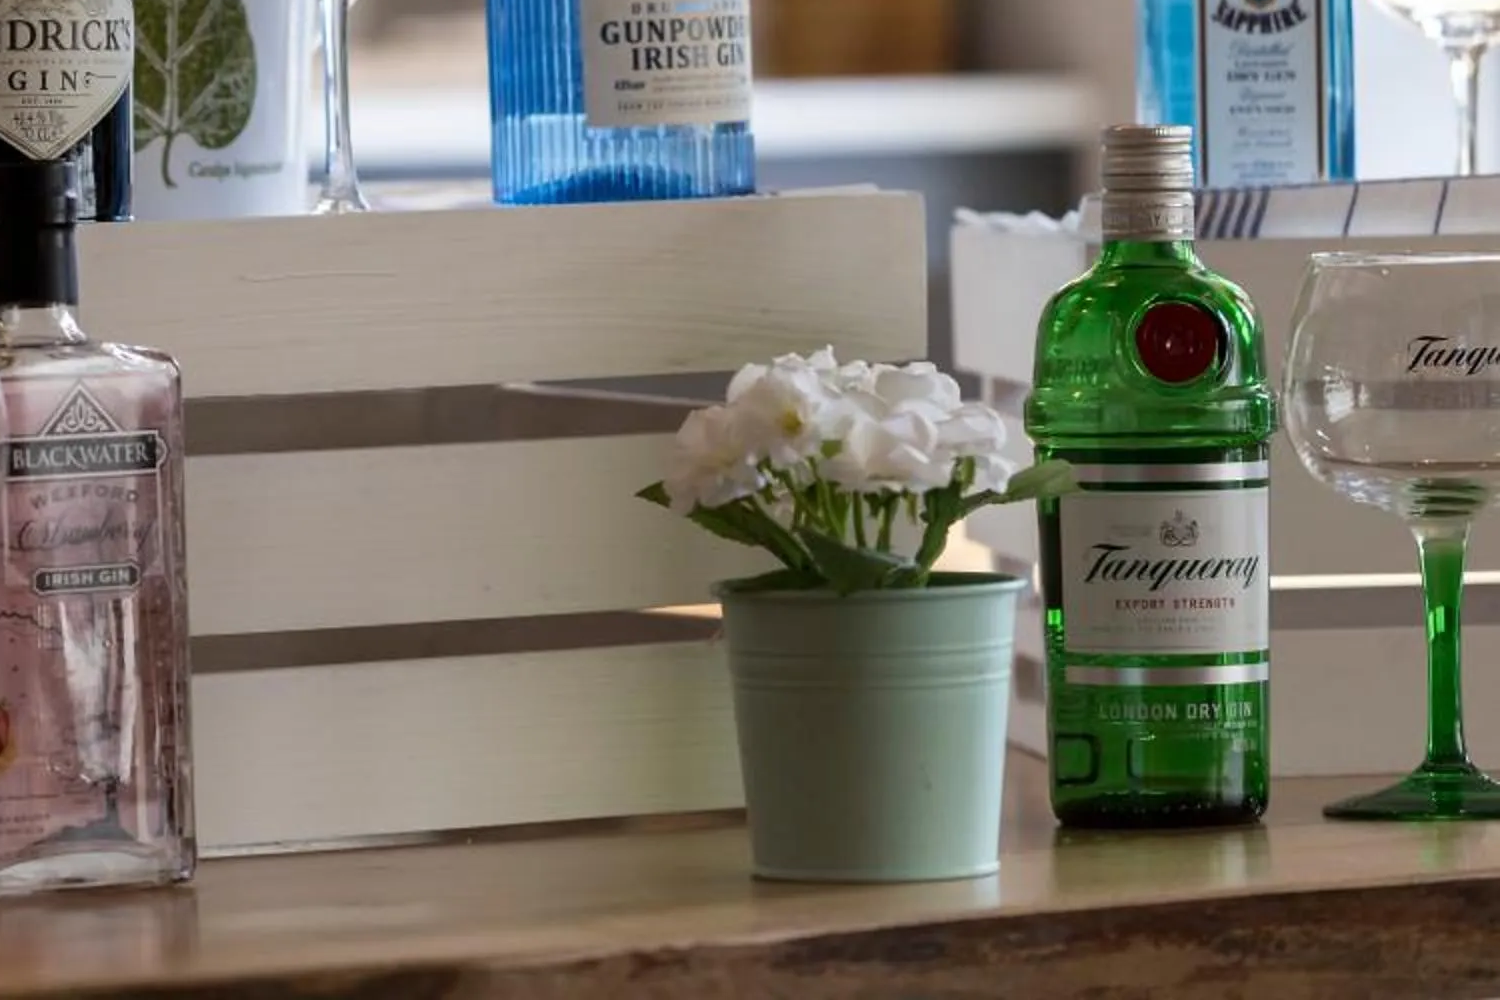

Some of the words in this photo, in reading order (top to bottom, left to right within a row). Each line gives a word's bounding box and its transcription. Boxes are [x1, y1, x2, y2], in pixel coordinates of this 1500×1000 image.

[599, 15, 746, 46] GUNPOWDE
[631, 44, 710, 71] IRISH
[716, 42, 745, 68] GIN
[7, 68, 79, 92] GIN
[12, 441, 150, 470] BLACKWATER
[32, 483, 141, 510] WEXFORD
[44, 571, 94, 587] IRISH
[98, 568, 131, 584] GIN
[1084, 543, 1261, 592] Tanqueray
[1115, 599, 1166, 611] EXPORT
[1173, 597, 1236, 611] STRENGTH
[1099, 701, 1178, 721] LONDON
[1186, 700, 1223, 720] DRY
[1226, 700, 1252, 718] GIN
